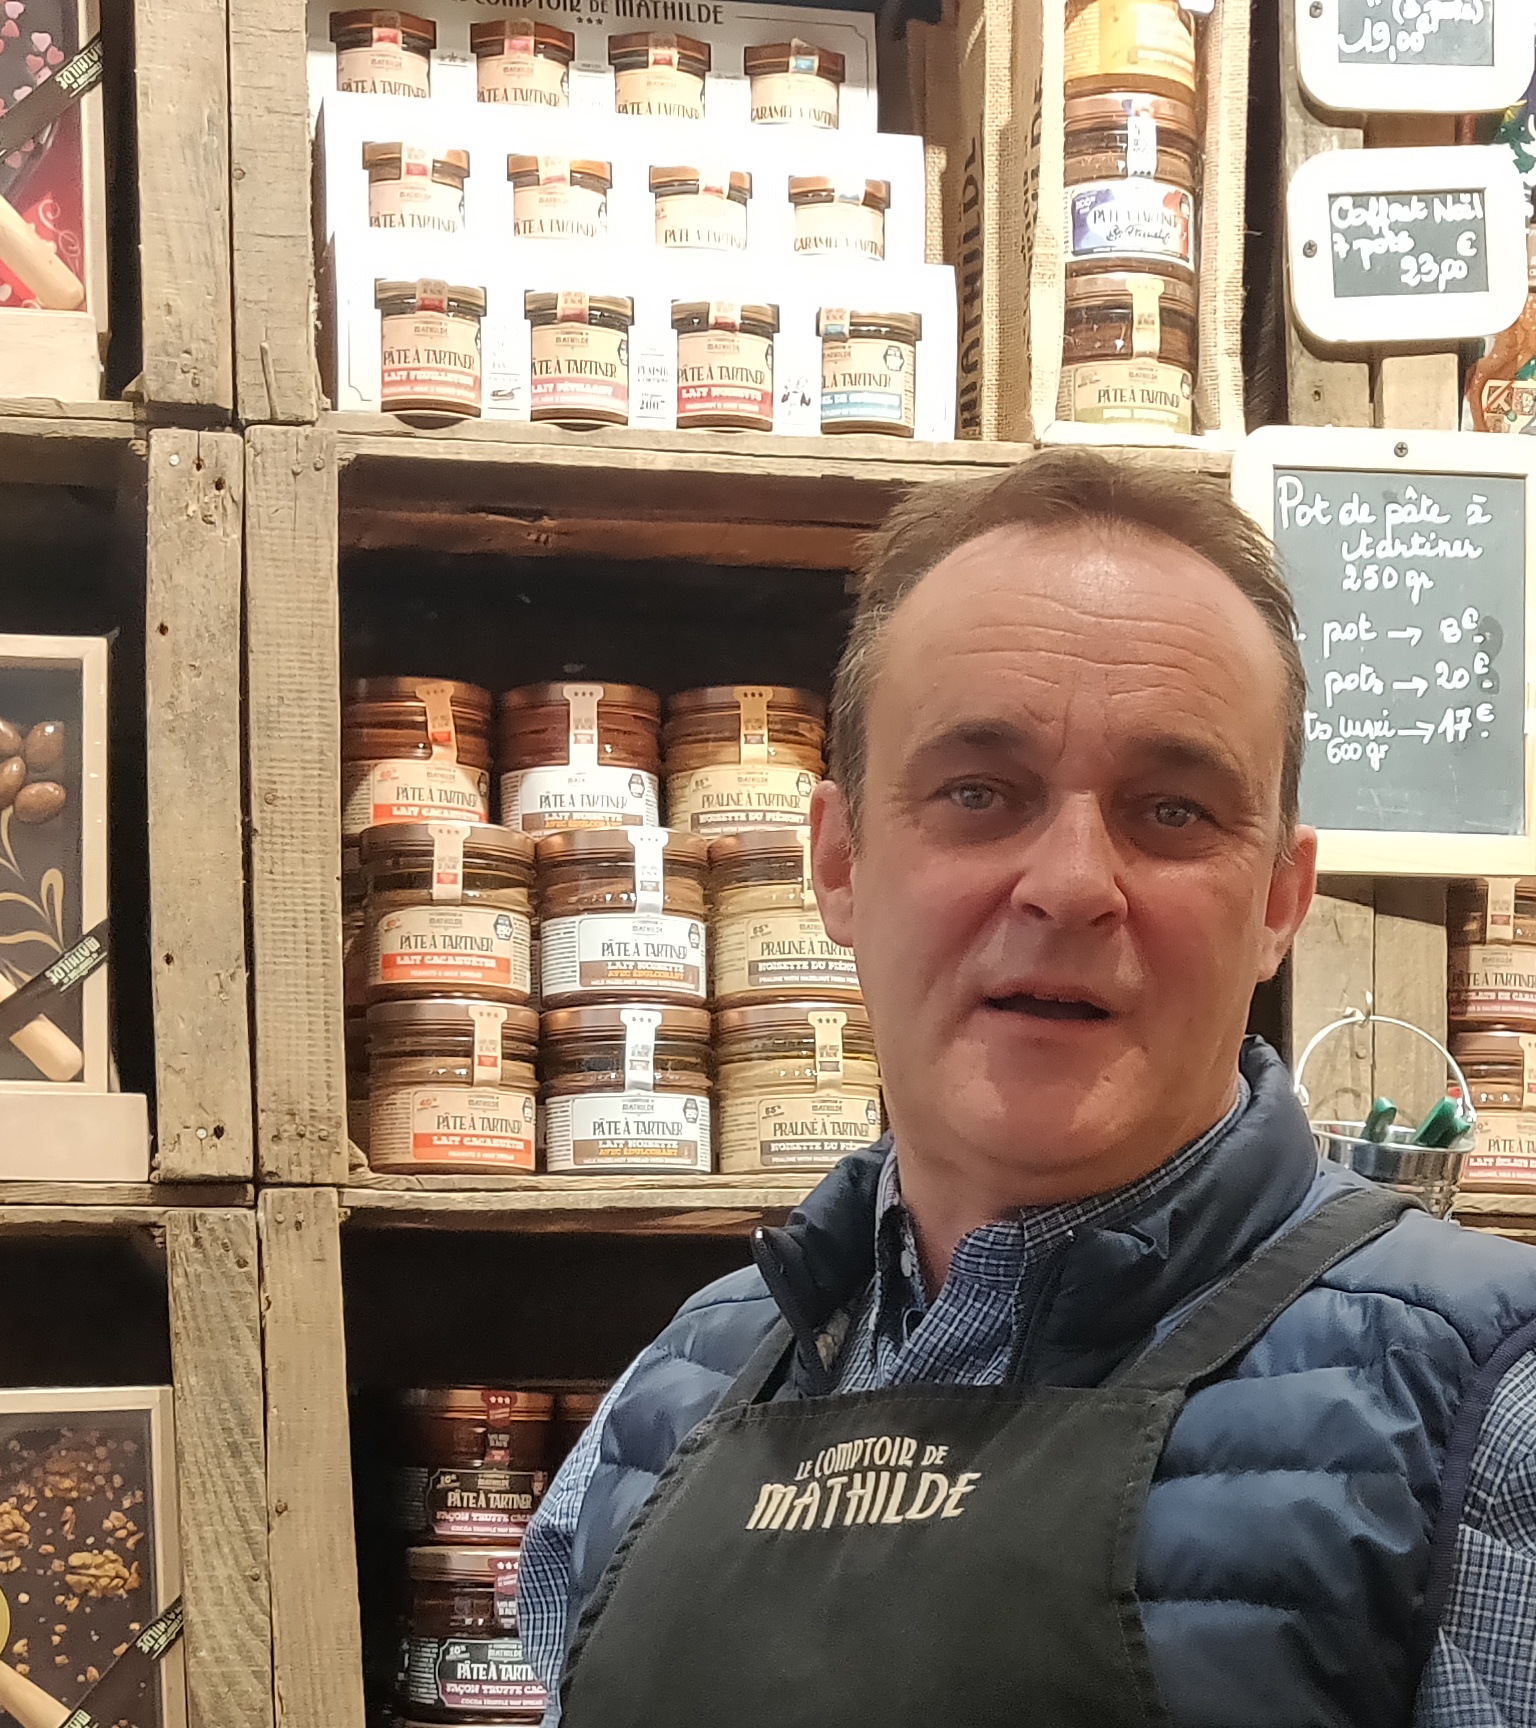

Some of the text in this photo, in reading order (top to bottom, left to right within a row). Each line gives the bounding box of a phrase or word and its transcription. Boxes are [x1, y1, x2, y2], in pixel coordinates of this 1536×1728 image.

[1331, 195, 1428, 234] Coffret
[424, 349, 475, 370] TARTINER
[717, 366, 766, 386] TARTINER
[1277, 475, 1492, 545] Pot de pâte à
[1342, 563, 1434, 605] 250 gr
[1323, 612, 1377, 659] pot
[1324, 663, 1384, 709] pots
[1327, 738, 1389, 772] 600 gr
[757, 793, 800, 809] TARTINER
[400, 932, 427, 951] PÂTE
[441, 934, 494, 953] TARTINER
[592, 1117, 683, 1137] PÂTE TARTINER
[794, 1436, 949, 1481] LE COMPTOIR DE
[447, 1490, 477, 1508] PÂTE
[488, 1493, 532, 1509] TARTINER
[744, 1471, 982, 1531] MATHILDE
